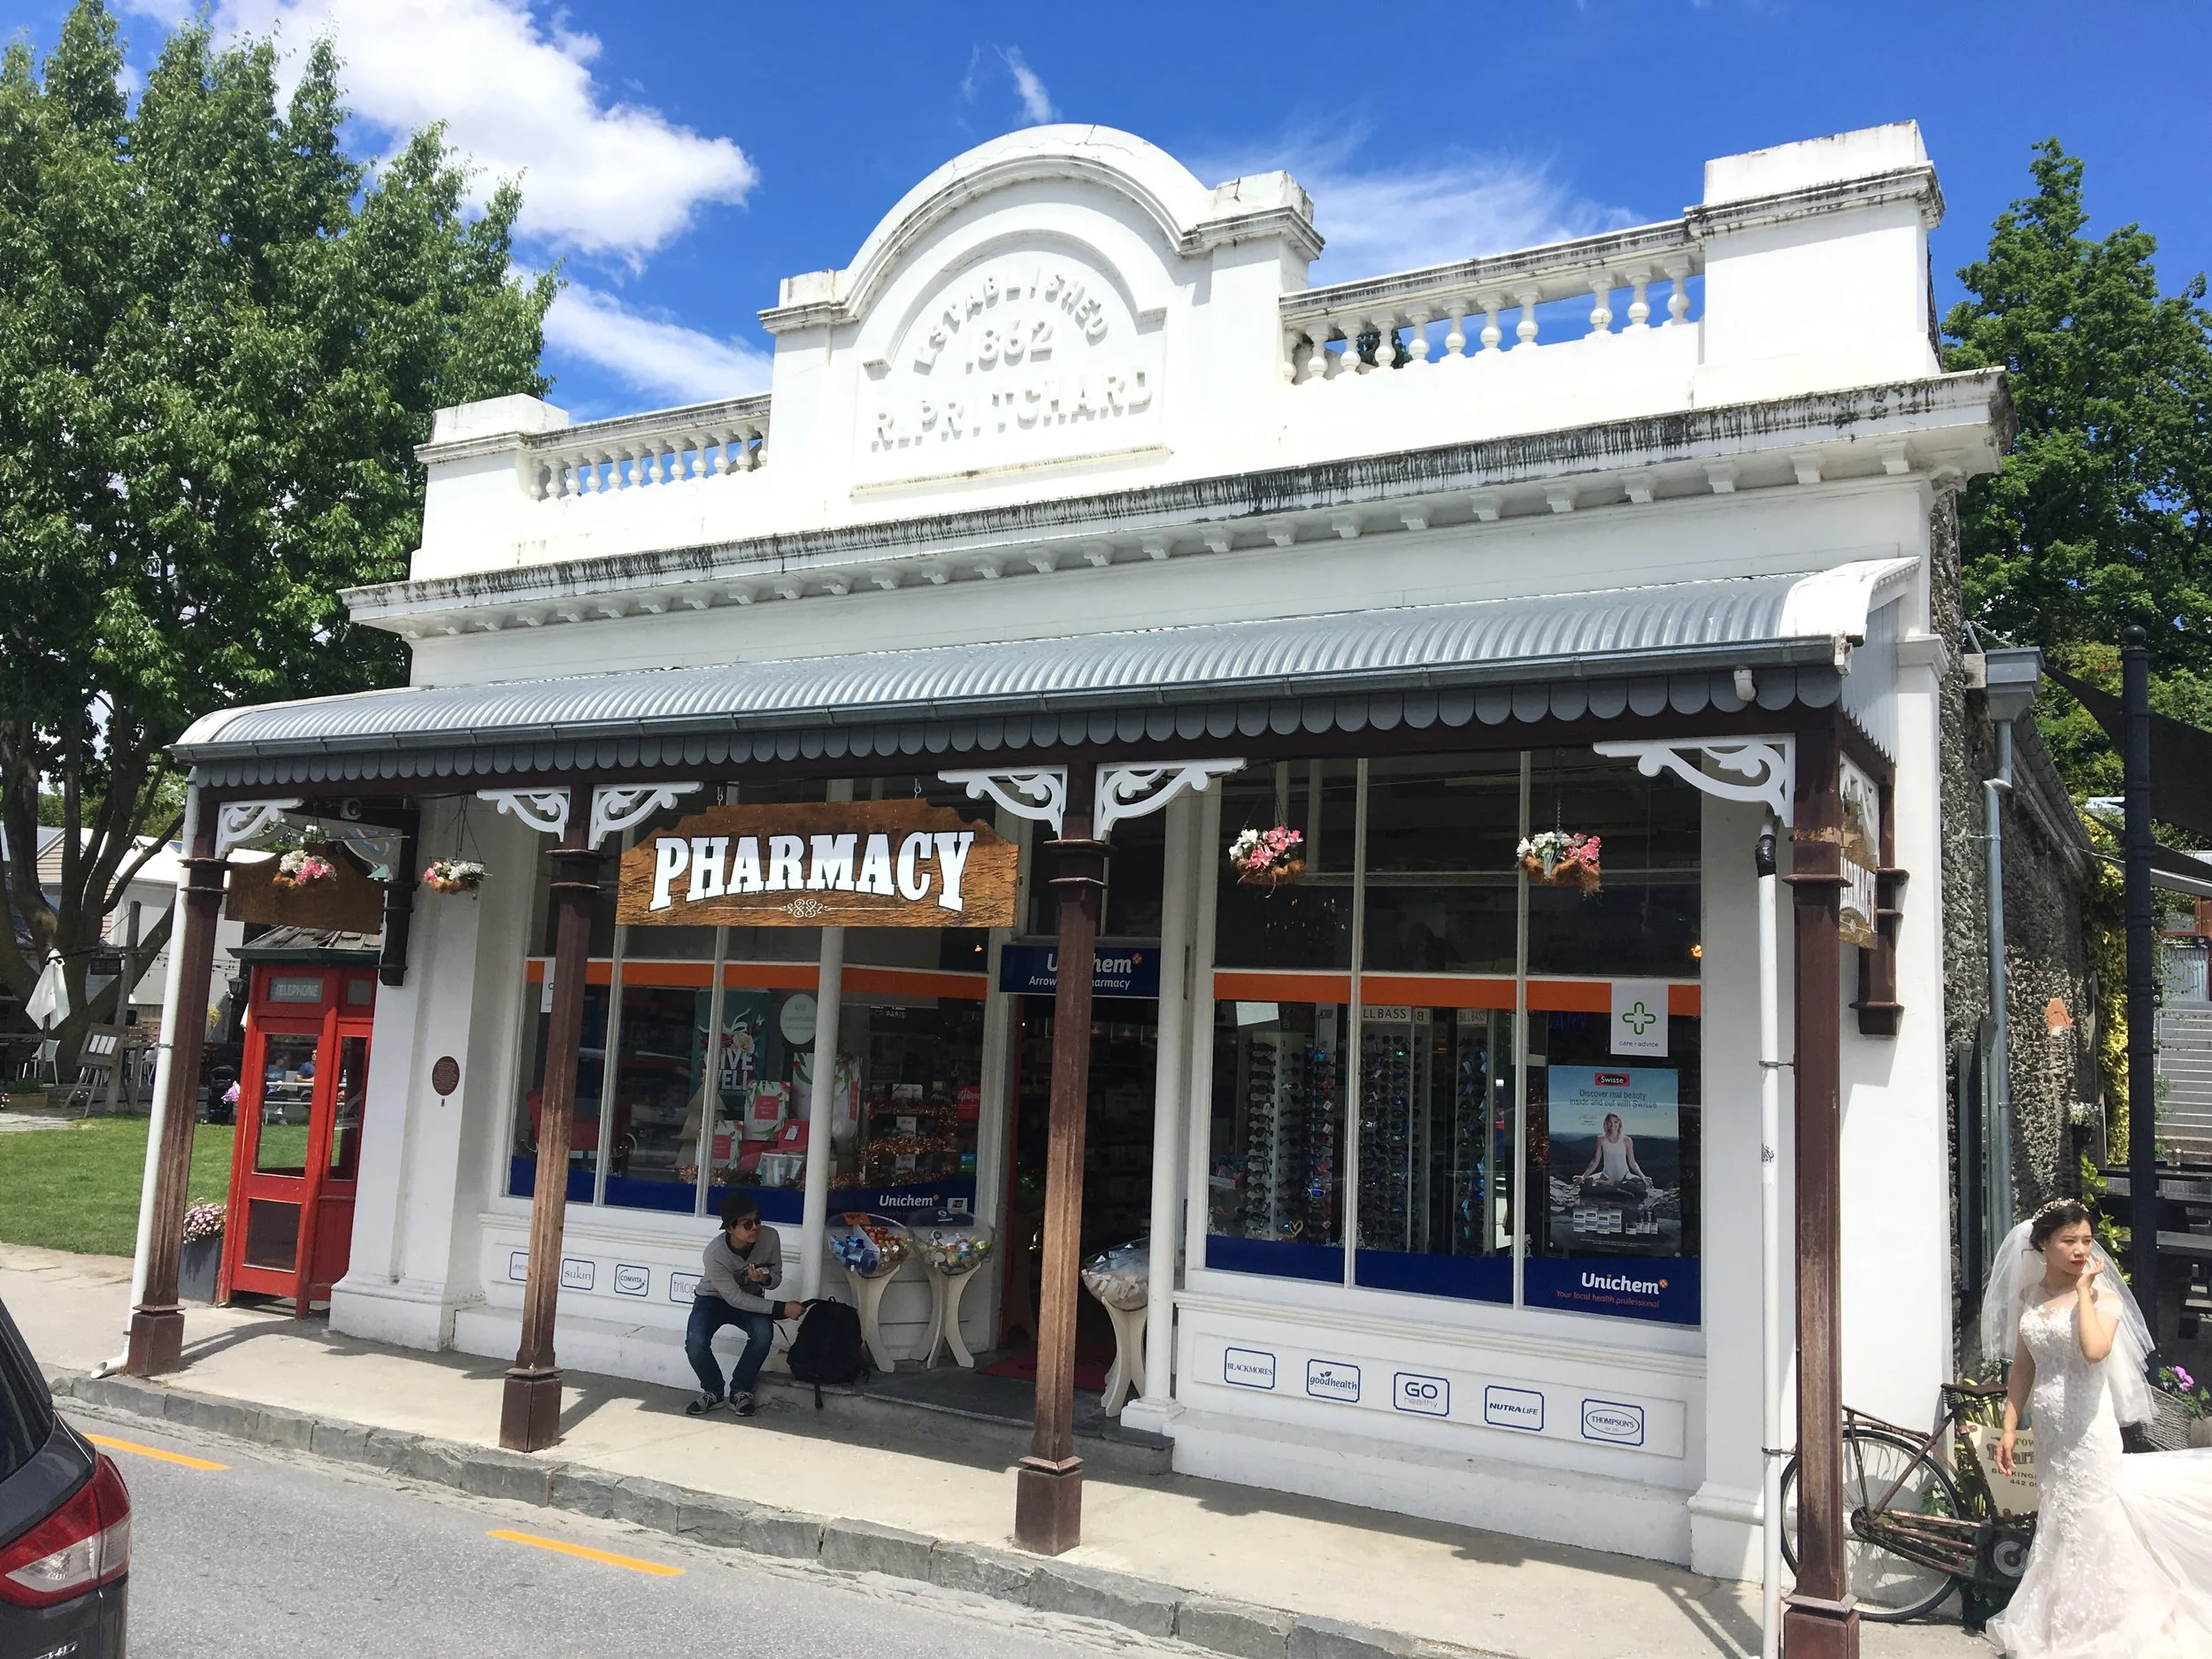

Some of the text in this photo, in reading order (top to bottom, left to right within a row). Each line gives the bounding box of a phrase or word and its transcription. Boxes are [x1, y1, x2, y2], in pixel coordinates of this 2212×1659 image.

[649, 830, 975, 912] PHARMACY
[1047, 953, 1132, 973] Uhem
[275, 983, 319, 997] TELEPHONE
[1092, 979, 1131, 990] armacy
[1378, 1008, 1406, 1019] BASS
[1601, 1075, 1624, 1084] Swisse
[1580, 1089, 1608, 1098] Discover
[1624, 1091, 1646, 1101] beauty
[1632, 1100, 1657, 1109] Swisse
[879, 1194, 933, 1207] Unichem
[565, 1266, 591, 1281] sukin
[619, 1274, 642, 1284] COMVITA
[673, 1279, 697, 1299] trilog
[1581, 1271, 1660, 1294] Unichem
[1556, 1289, 1660, 1308] Your local health professional
[1226, 1363, 1273, 1376] BLACKMORES
[1404, 1381, 1439, 1399] GO
[1403, 1395, 1439, 1409] healthy
